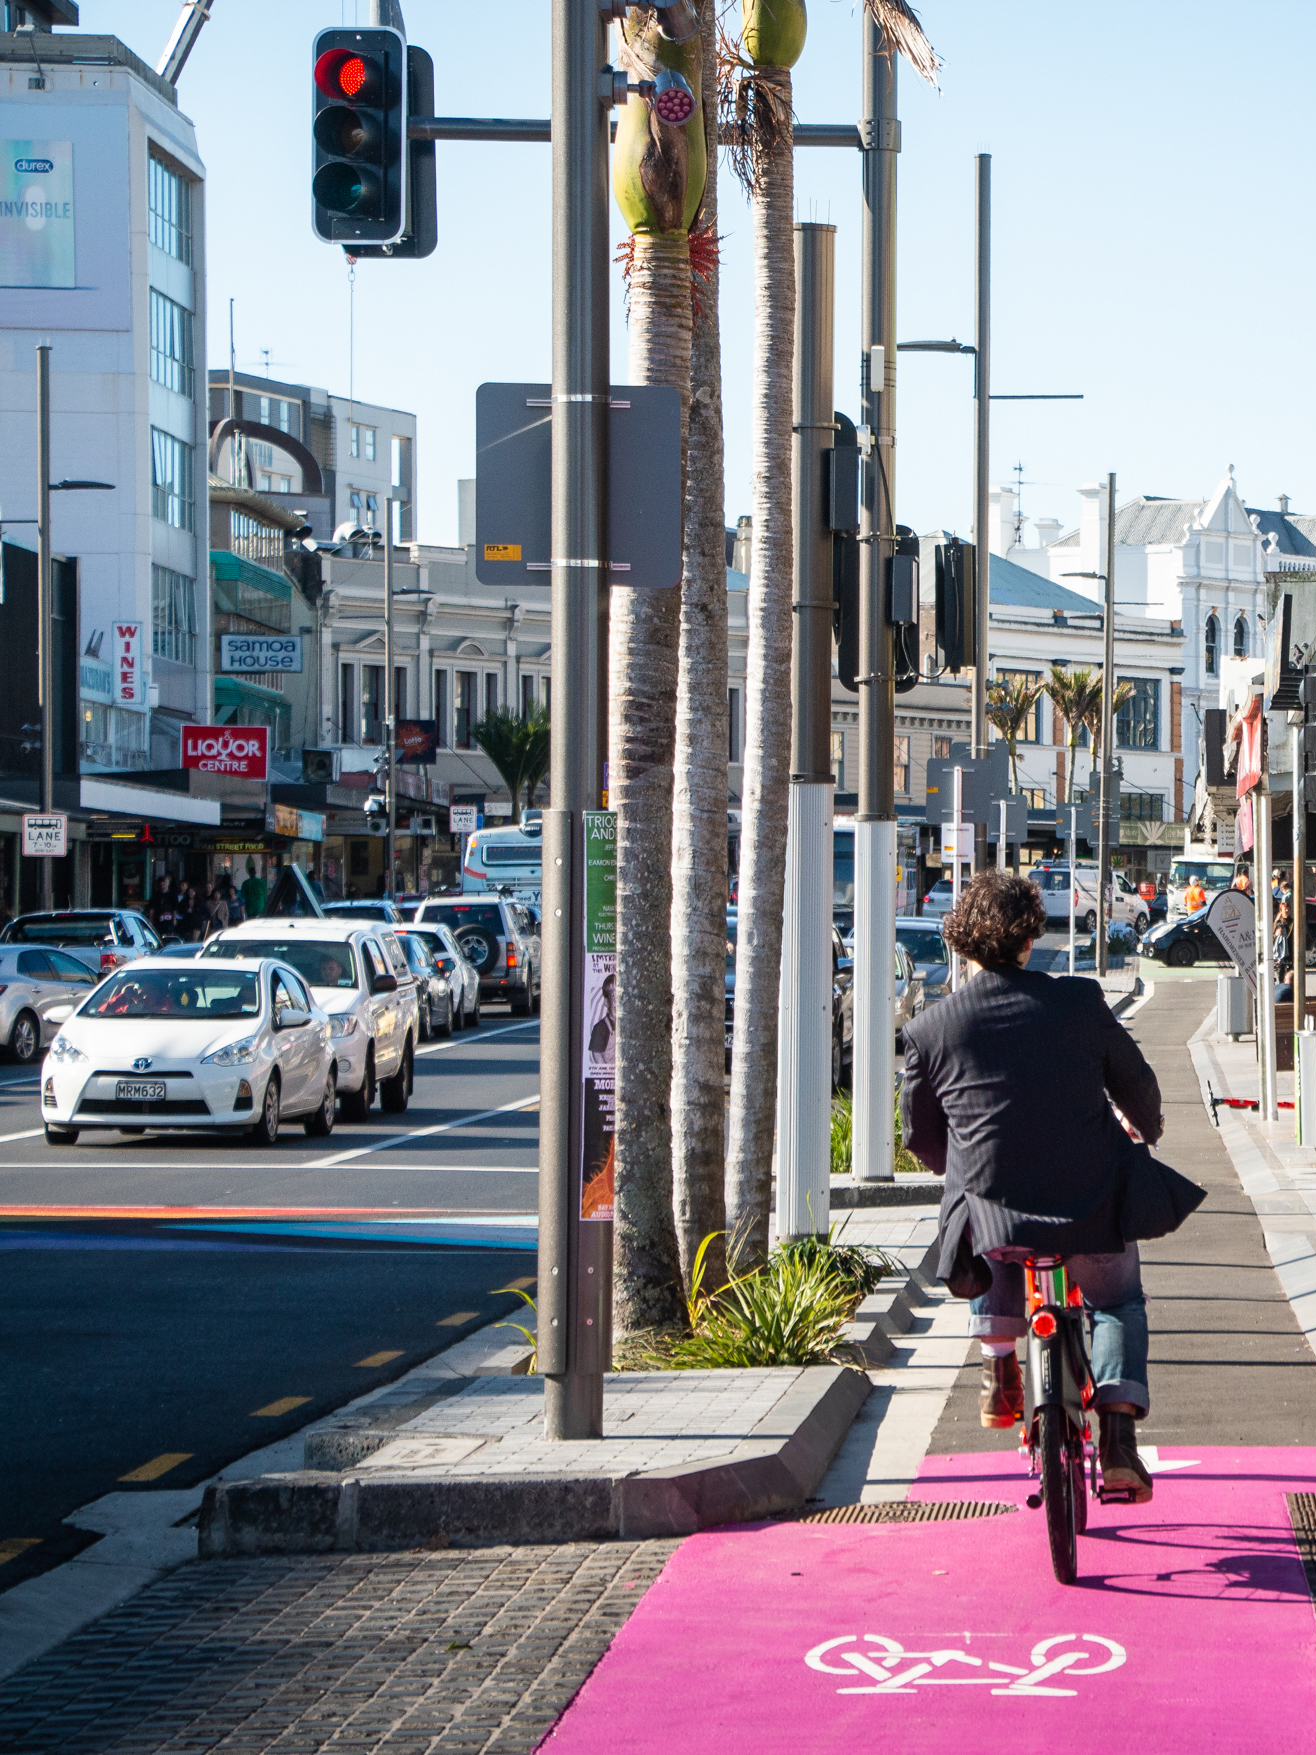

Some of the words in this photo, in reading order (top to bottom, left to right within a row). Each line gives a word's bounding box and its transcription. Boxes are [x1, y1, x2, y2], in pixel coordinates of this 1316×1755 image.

[16, 160, 51, 171] durex
[0, 202, 70, 219] INVISIBLE
[116, 625, 138, 700] WINES
[403, 736, 423, 746] Lotto
[187, 737, 263, 762] LIQUOR
[198, 760, 249, 773] CENTRE
[28, 831, 61, 842] LANE
[590, 827, 615, 840] AND
[215, 842, 244, 851] STREET
[245, 842, 265, 851] FOOD
[1217, 926, 1246, 968] HAIRDRESSER
[117, 1085, 164, 1098] MRM632
